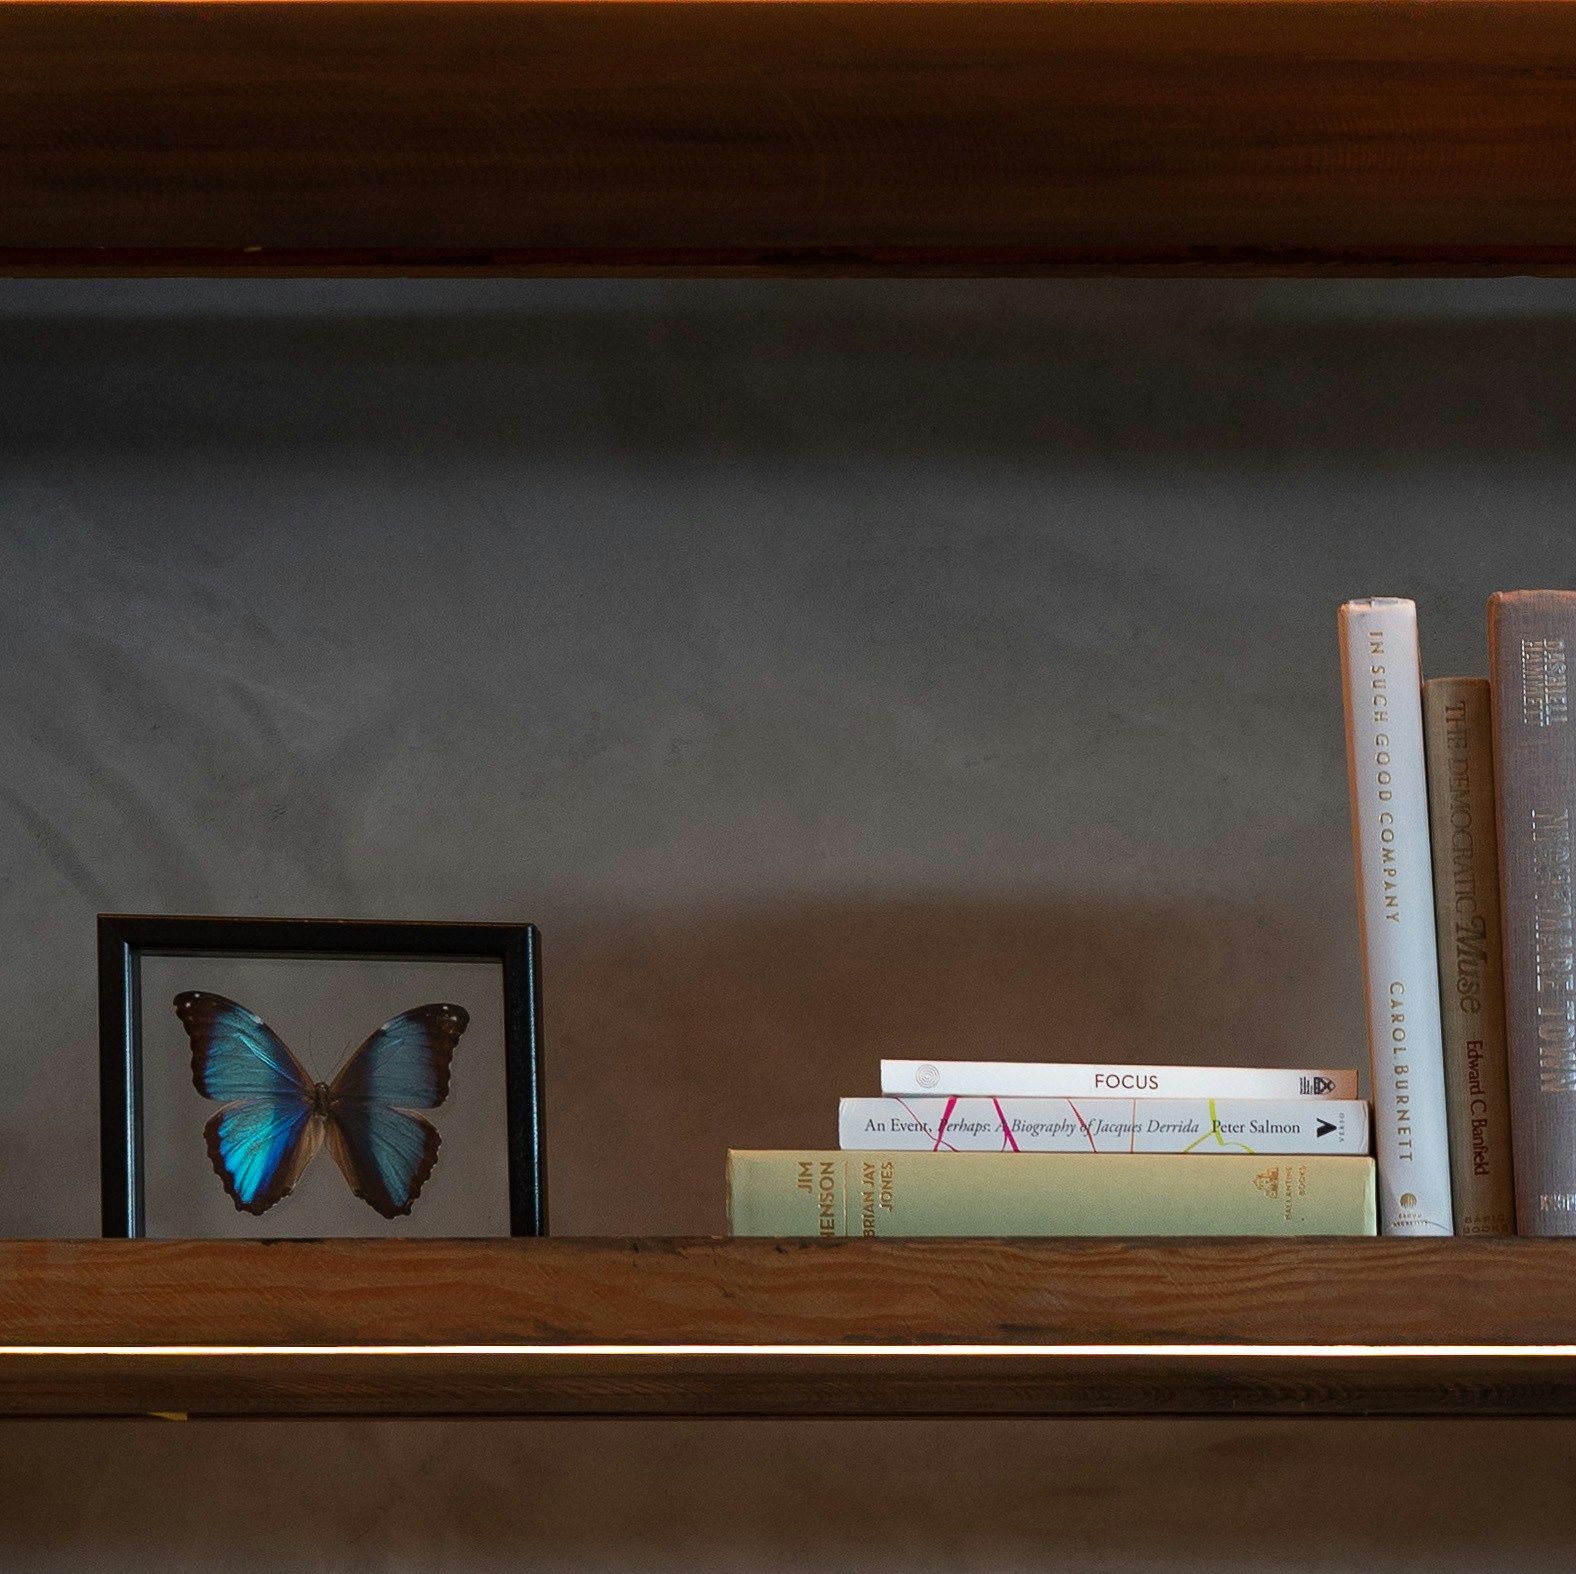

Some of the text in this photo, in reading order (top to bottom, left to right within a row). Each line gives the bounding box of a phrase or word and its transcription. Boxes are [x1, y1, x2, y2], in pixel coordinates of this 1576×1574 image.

[1369, 631, 1400, 923] IN SUCH GOOD COMPANY
[1095, 1073, 1159, 1090] FOCUS
[1389, 981, 1413, 1162] CAROL BURNETT
[864, 1118, 886, 1133] An
[891, 1119, 932, 1137] Event,
[937, 1119, 992, 1139] Perhaps:
[1011, 1118, 1077, 1141] Biography
[1080, 1118, 1097, 1139] of
[1094, 1119, 1143, 1140] Jacques
[1147, 1118, 1199, 1134] Derrida
[1211, 1119, 1247, 1134] Peter
[1249, 1119, 1301, 1134] Salmon
[798, 1161, 813, 1194] JIM
[862, 1162, 876, 1239] BRIAN JAY
[880, 1161, 894, 1213] JONES
